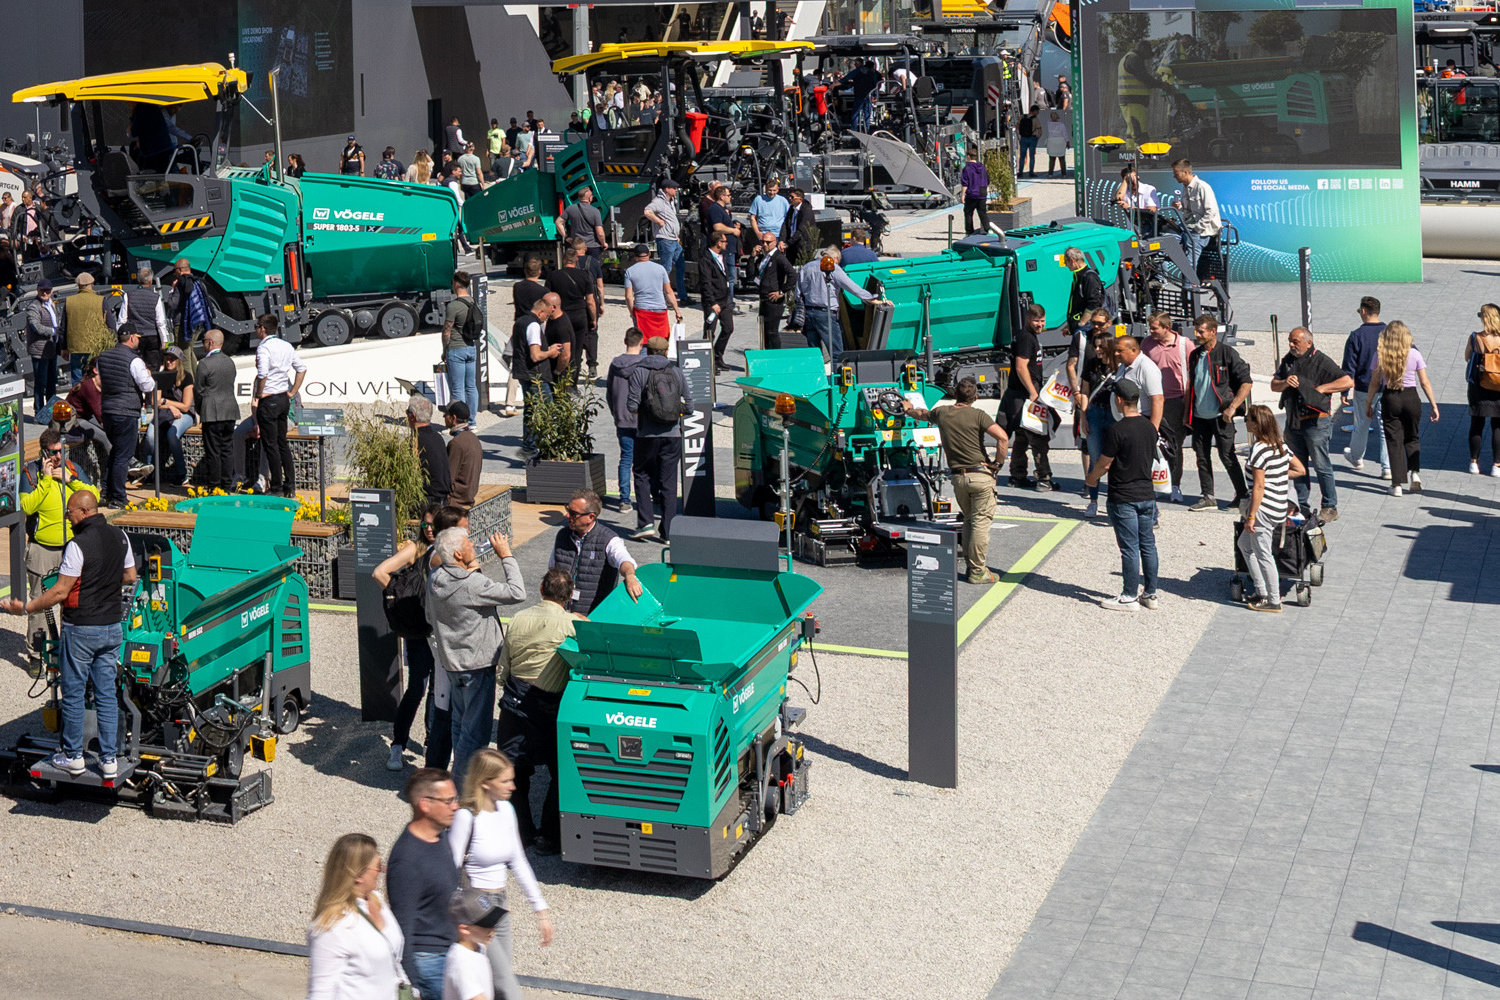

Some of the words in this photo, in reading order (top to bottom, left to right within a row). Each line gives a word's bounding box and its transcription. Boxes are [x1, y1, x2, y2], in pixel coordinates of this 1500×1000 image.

[1251, 82, 1275, 90] VÖGELE
[1451, 180, 1480, 188] HAMM
[333, 209, 384, 221] VÖGELE
[508, 204, 535, 219] VÖGELE
[313, 223, 335, 231] SUPER
[480, 329, 488, 382] NEW
[305, 381, 348, 396] ON
[1052, 382, 1073, 398] PERI
[684, 410, 706, 477] NEW
[1152, 467, 1168, 481] ERI
[249, 603, 270, 621] VÖGELE
[738, 682, 755, 706] VÖGELE
[605, 712, 657, 728] VÖGELE
